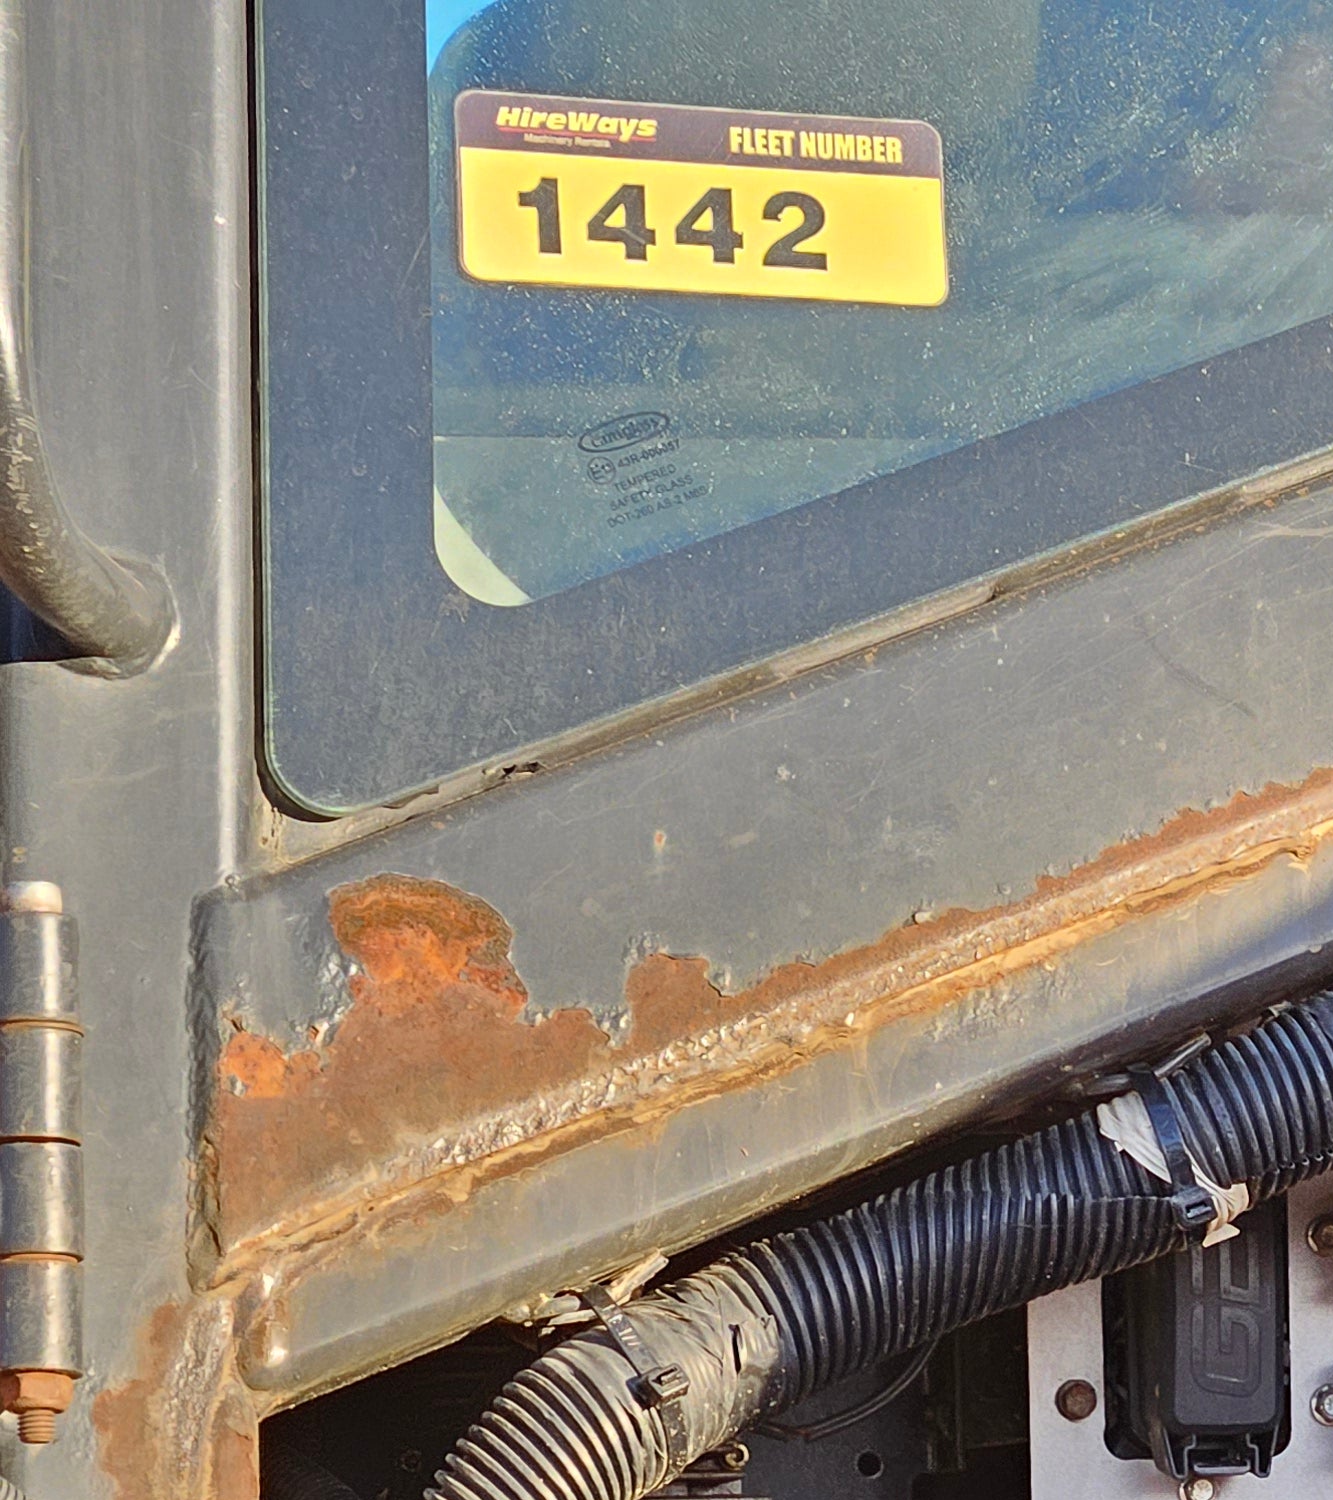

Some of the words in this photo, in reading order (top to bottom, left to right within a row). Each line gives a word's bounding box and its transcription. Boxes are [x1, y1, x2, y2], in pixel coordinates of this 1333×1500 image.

[496, 106, 658, 143] HireWays
[729, 126, 795, 158] FLEET
[799, 131, 903, 164] NUMBER
[518, 177, 828, 271] 1442
